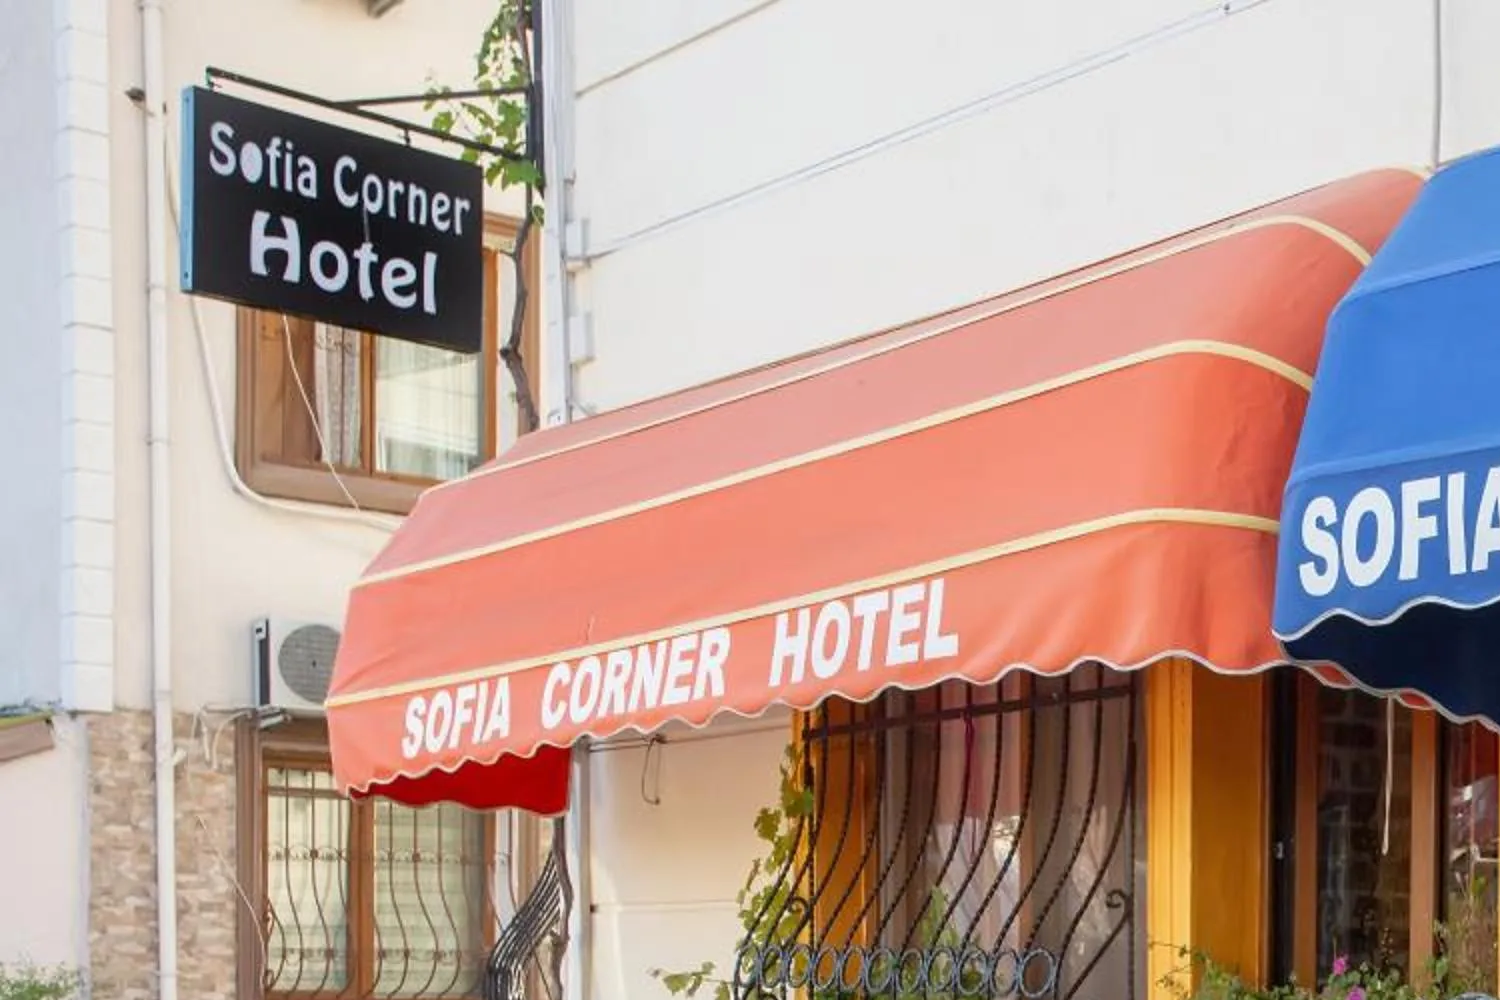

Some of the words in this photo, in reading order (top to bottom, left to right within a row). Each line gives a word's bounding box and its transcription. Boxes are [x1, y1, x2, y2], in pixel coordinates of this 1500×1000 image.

[208, 120, 318, 199] Sofia
[333, 155, 471, 235] Corner
[249, 209, 438, 315] Hotel
[401, 676, 511, 759] SOFIA
[541, 625, 731, 729] CORNER
[767, 578, 959, 688] HOTEL
